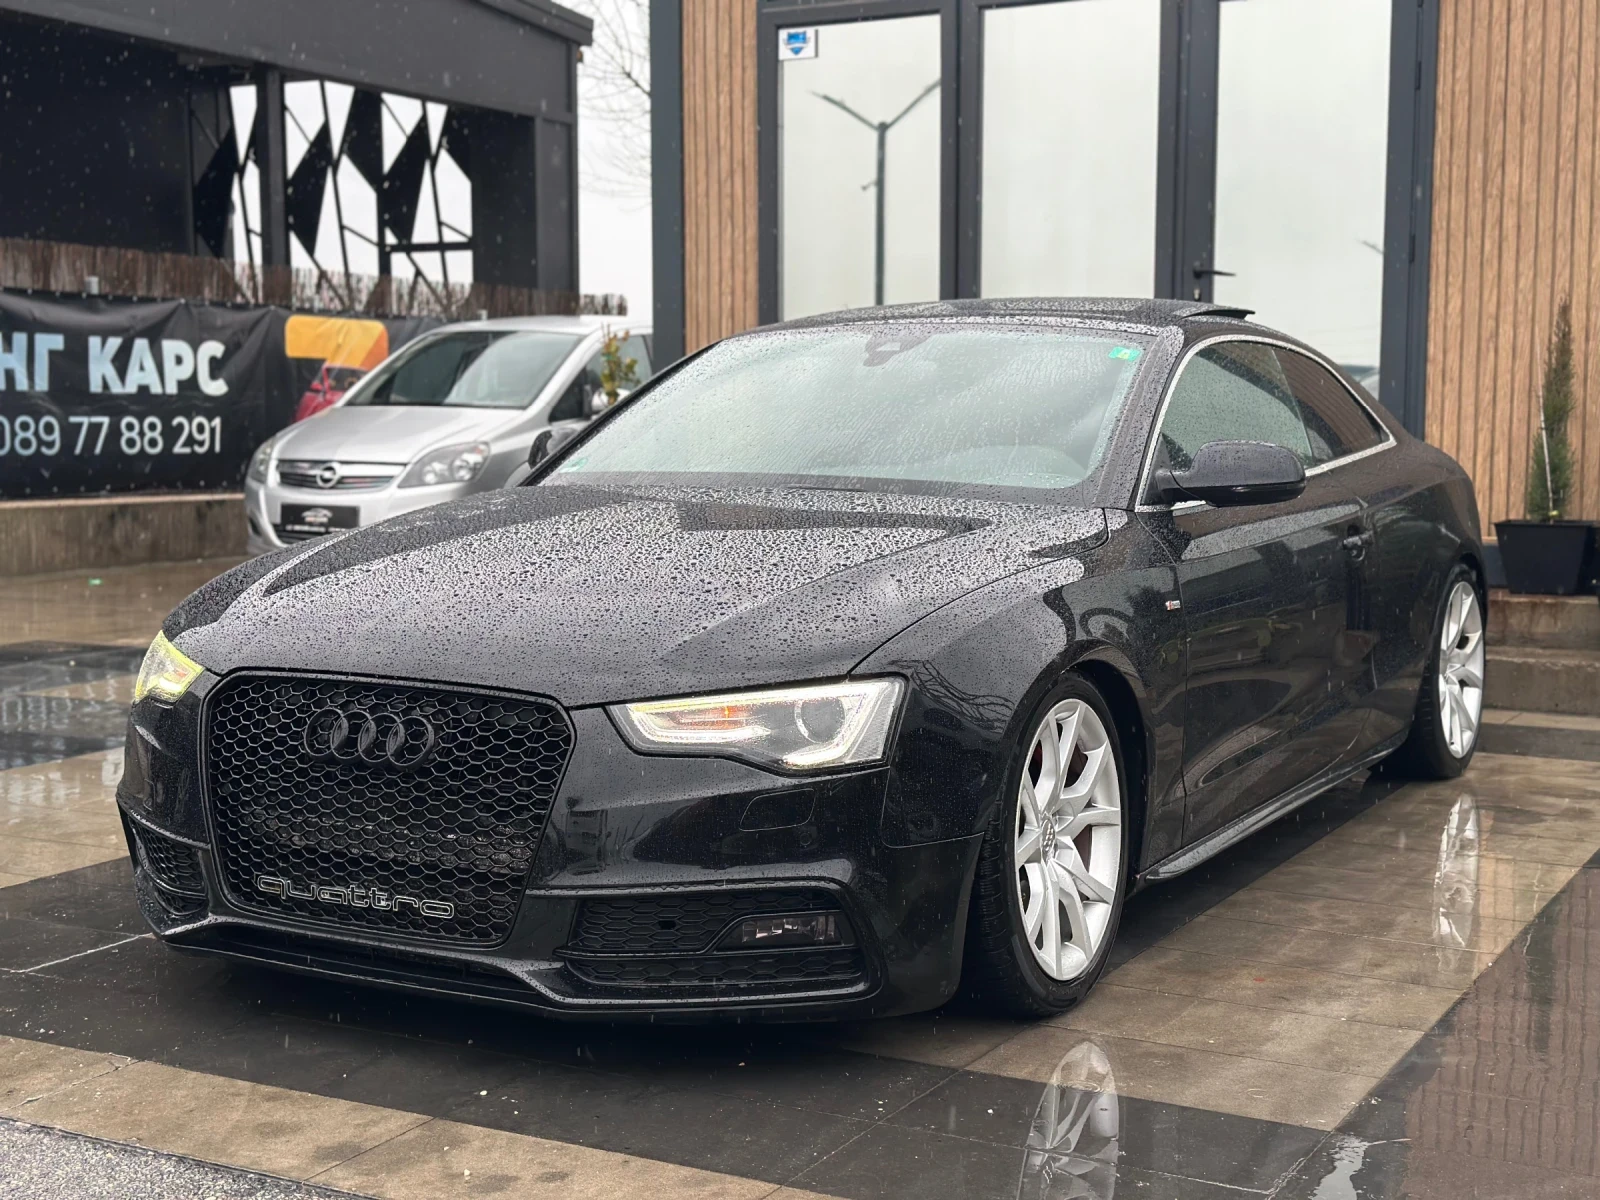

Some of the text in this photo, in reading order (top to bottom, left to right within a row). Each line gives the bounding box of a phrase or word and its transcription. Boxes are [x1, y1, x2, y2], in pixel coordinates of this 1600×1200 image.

[0, 331, 229, 396] НГ КАРС
[68, 415, 110, 456] 77
[120, 415, 164, 455] 88
[171, 415, 221, 454] 291
[256, 874, 454, 919] quattro
